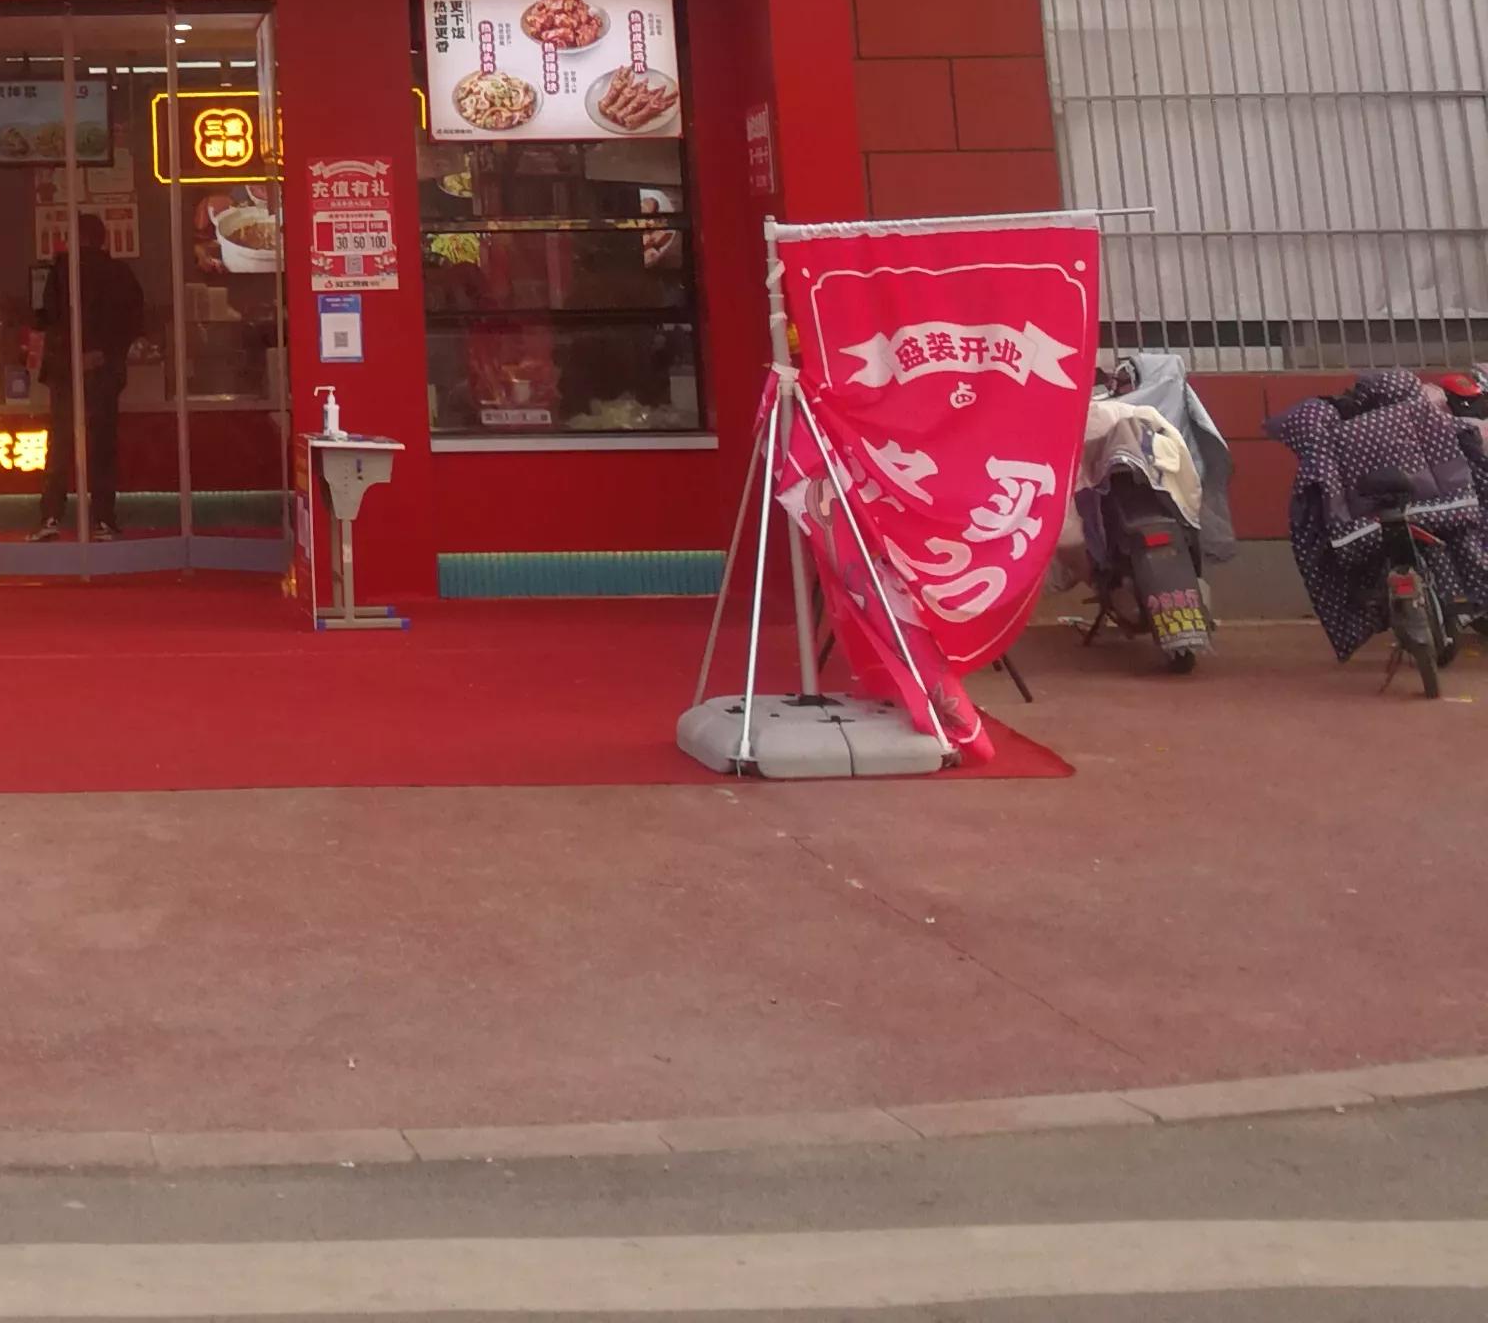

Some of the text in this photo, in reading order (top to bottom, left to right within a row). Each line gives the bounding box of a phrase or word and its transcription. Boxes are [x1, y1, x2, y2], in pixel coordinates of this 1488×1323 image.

[312, 179, 390, 198] 充值有礼
[894, 335, 1023, 374] 盛装开业
